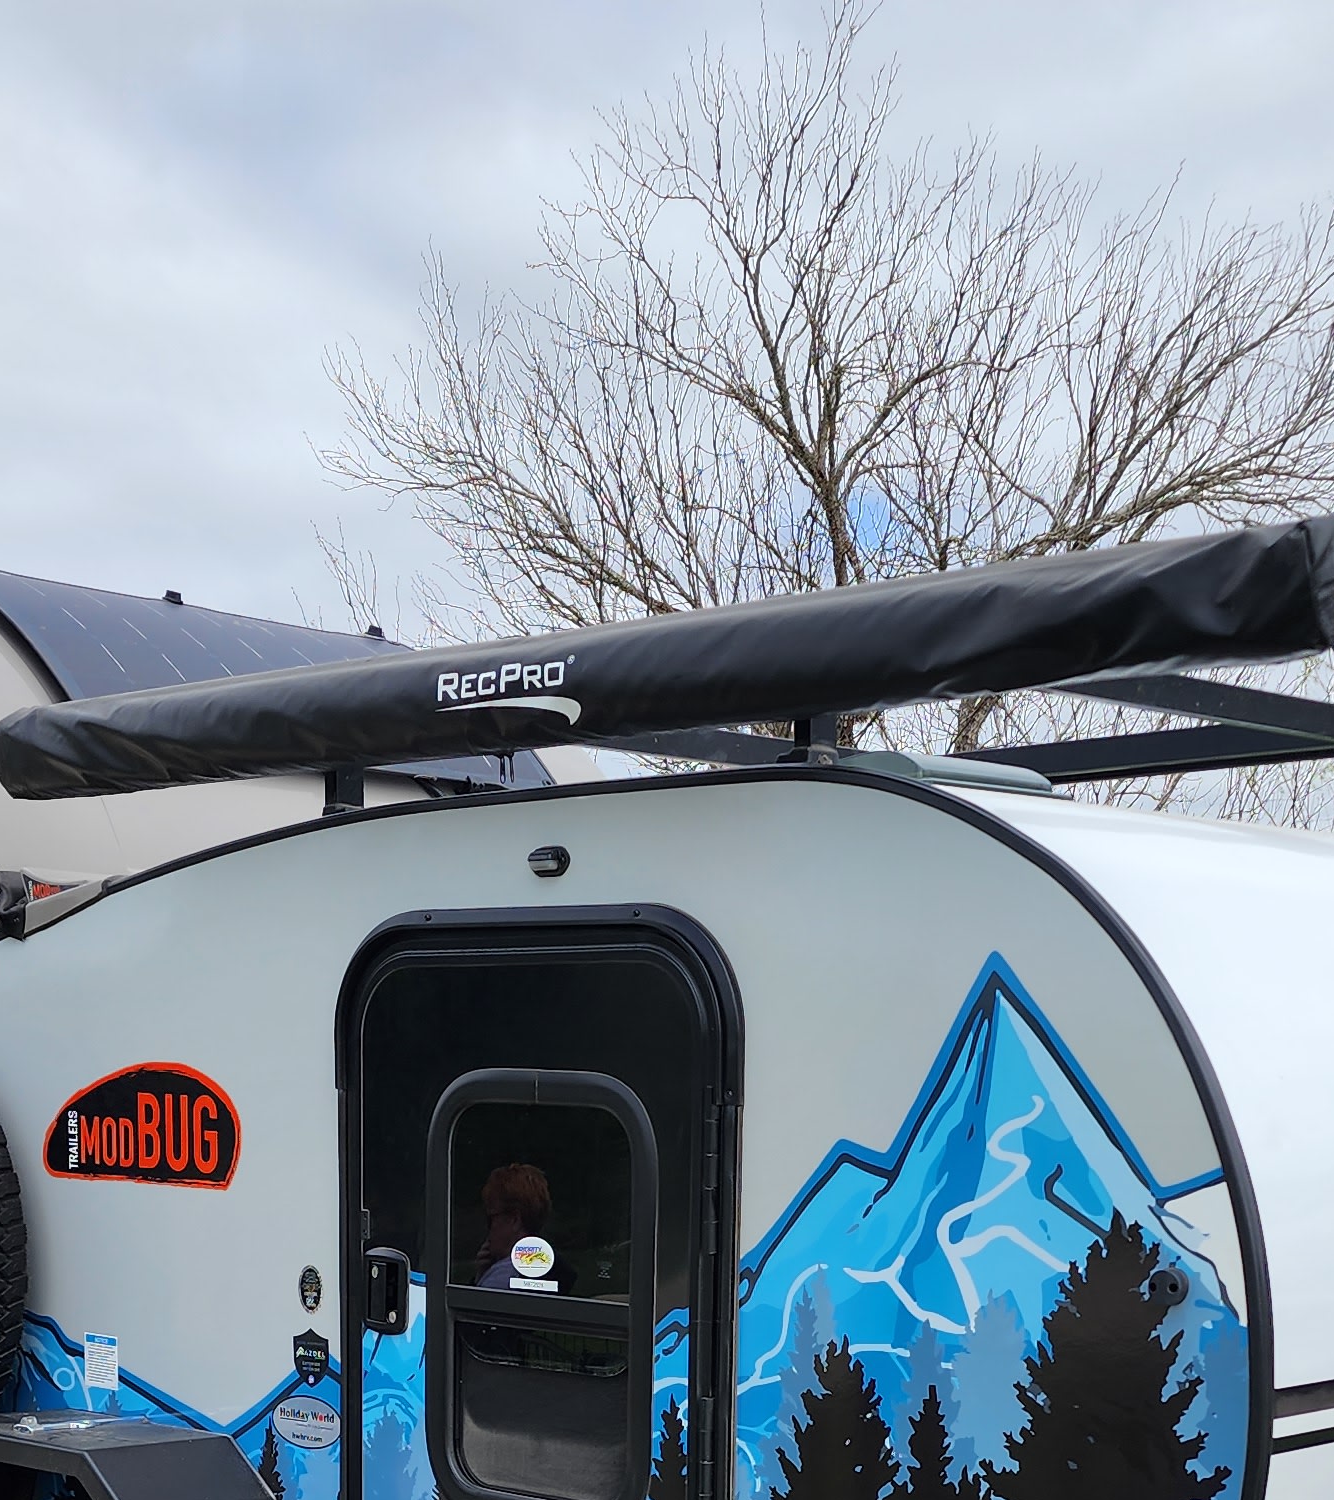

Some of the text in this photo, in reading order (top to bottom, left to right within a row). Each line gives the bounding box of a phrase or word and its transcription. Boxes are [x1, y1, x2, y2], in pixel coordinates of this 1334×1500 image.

[67, 1110, 79, 1170] TRAILERS
[79, 1091, 219, 1174] MODBUG
[279, 1406, 335, 1424] Holiday World
